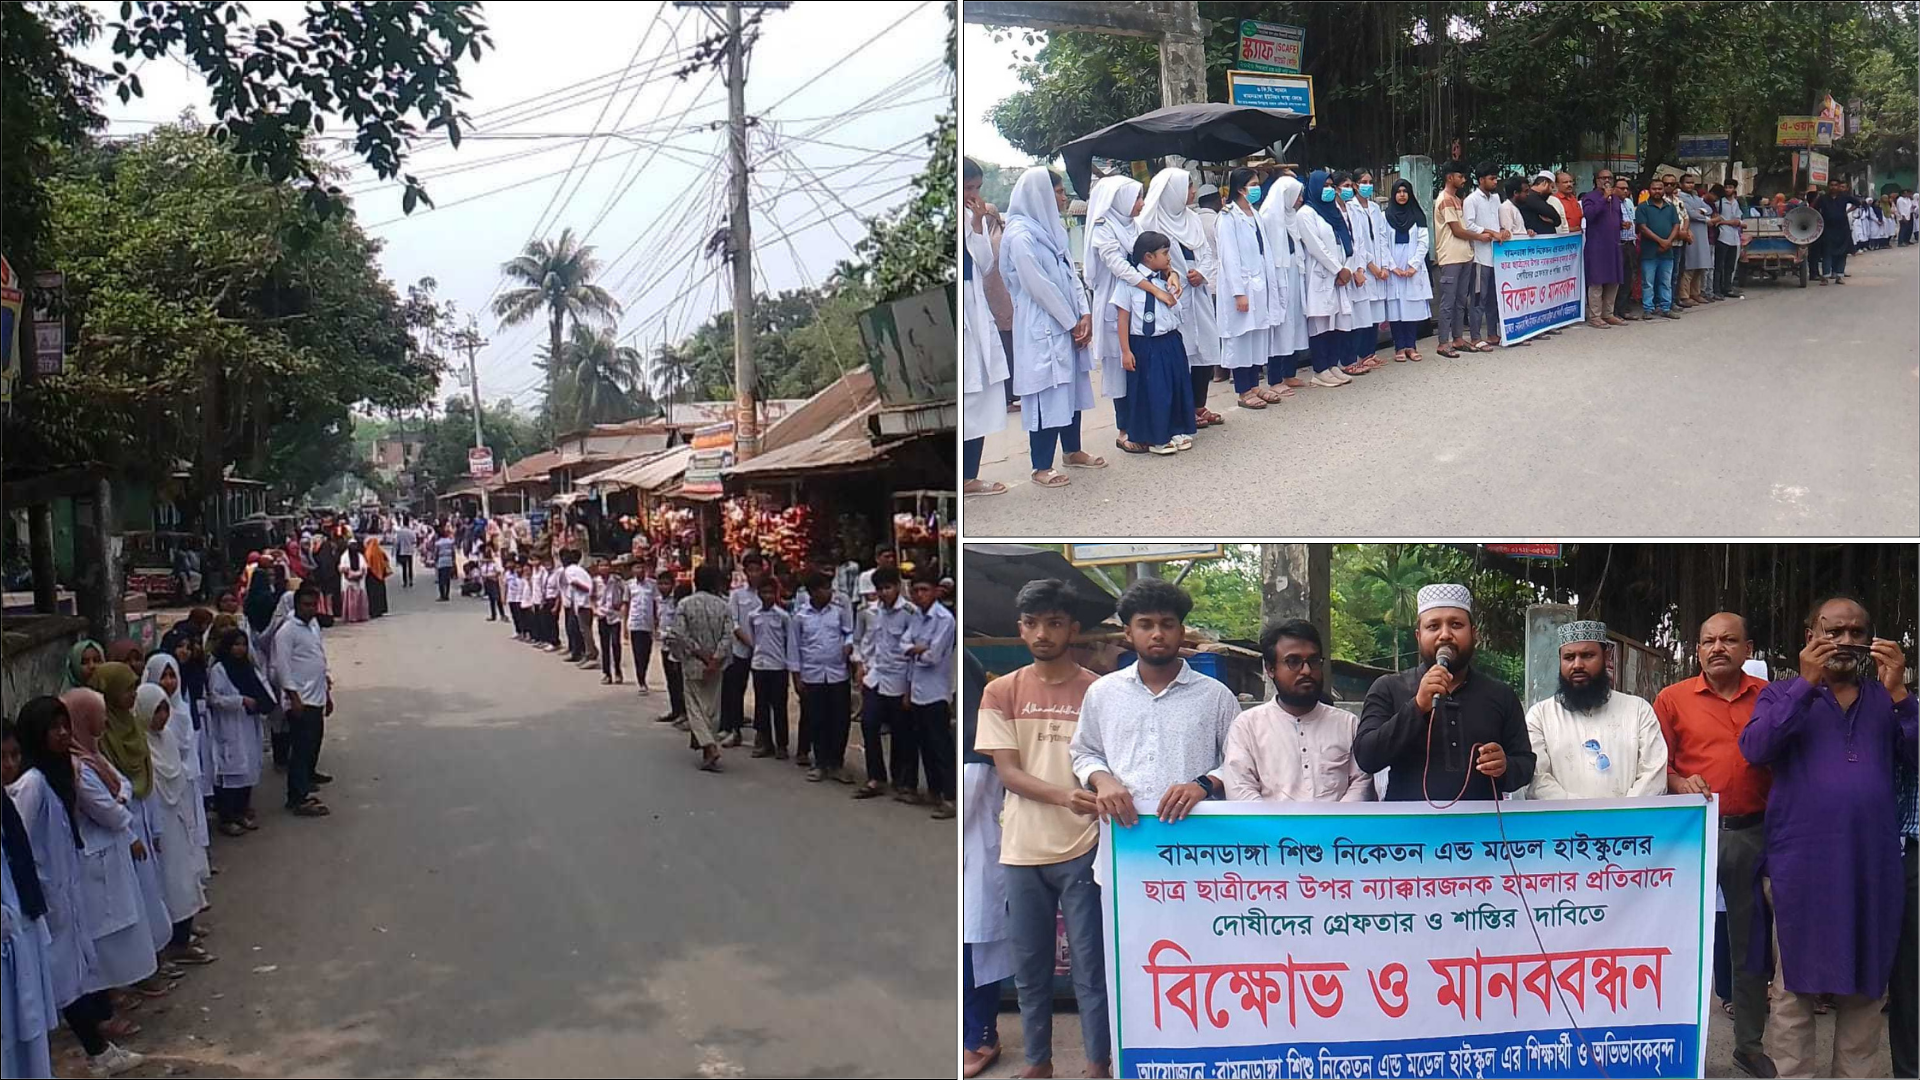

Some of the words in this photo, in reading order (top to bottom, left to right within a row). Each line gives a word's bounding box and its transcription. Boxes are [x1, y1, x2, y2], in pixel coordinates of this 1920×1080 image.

[1501, 281, 1537, 313] বিক্ষোভ
[1539, 286, 1546, 304] ও
[1049, 722, 1061, 731] For
[1156, 842, 1270, 866] বামনডাঙ্গা
[1277, 837, 1324, 866] শিশু
[1332, 837, 1426, 865] নিকেতন
[1434, 841, 1476, 862] এন্ড
[1481, 839, 1546, 860] মডেল
[1553, 831, 1654, 863] হাইস্কুলের
[1142, 878, 1187, 904] ছাত্র
[1194, 871, 1290, 904] ছাত্রীদের
[1296, 873, 1354, 901] উপর
[1360, 875, 1494, 901] ন্যাক্কারজনক
[1500, 870, 1579, 897] হামলার
[1586, 863, 1675, 890] প্রতিবাদে
[1212, 908, 1314, 936] দোষীদের
[1323, 911, 1416, 936] গ্রেফতার
[1424, 912, 1443, 931] ও
[1450, 902, 1518, 931] শাস্তির
[1532, 899, 1608, 928] দাবিতে
[1141, 939, 1350, 1033] বিক্ষোভ
[1367, 962, 1410, 1019] ও
[1427, 946, 1672, 1022] মানববন্ধন
[1286, 1047, 1314, 1079] শিশু
[1317, 1046, 1373, 1079] নিকেতন
[1378, 1053, 1402, 1078] এন্ড
[1405, 1050, 1445, 1077] মডেল
[1449, 1040, 1497, 1079] হাইস্কুল
[1501, 1045, 1523, 1072] এর
[1526, 1032, 1572, 1072] শিক্ষার্থী
[1577, 1042, 1588, 1067] ও
